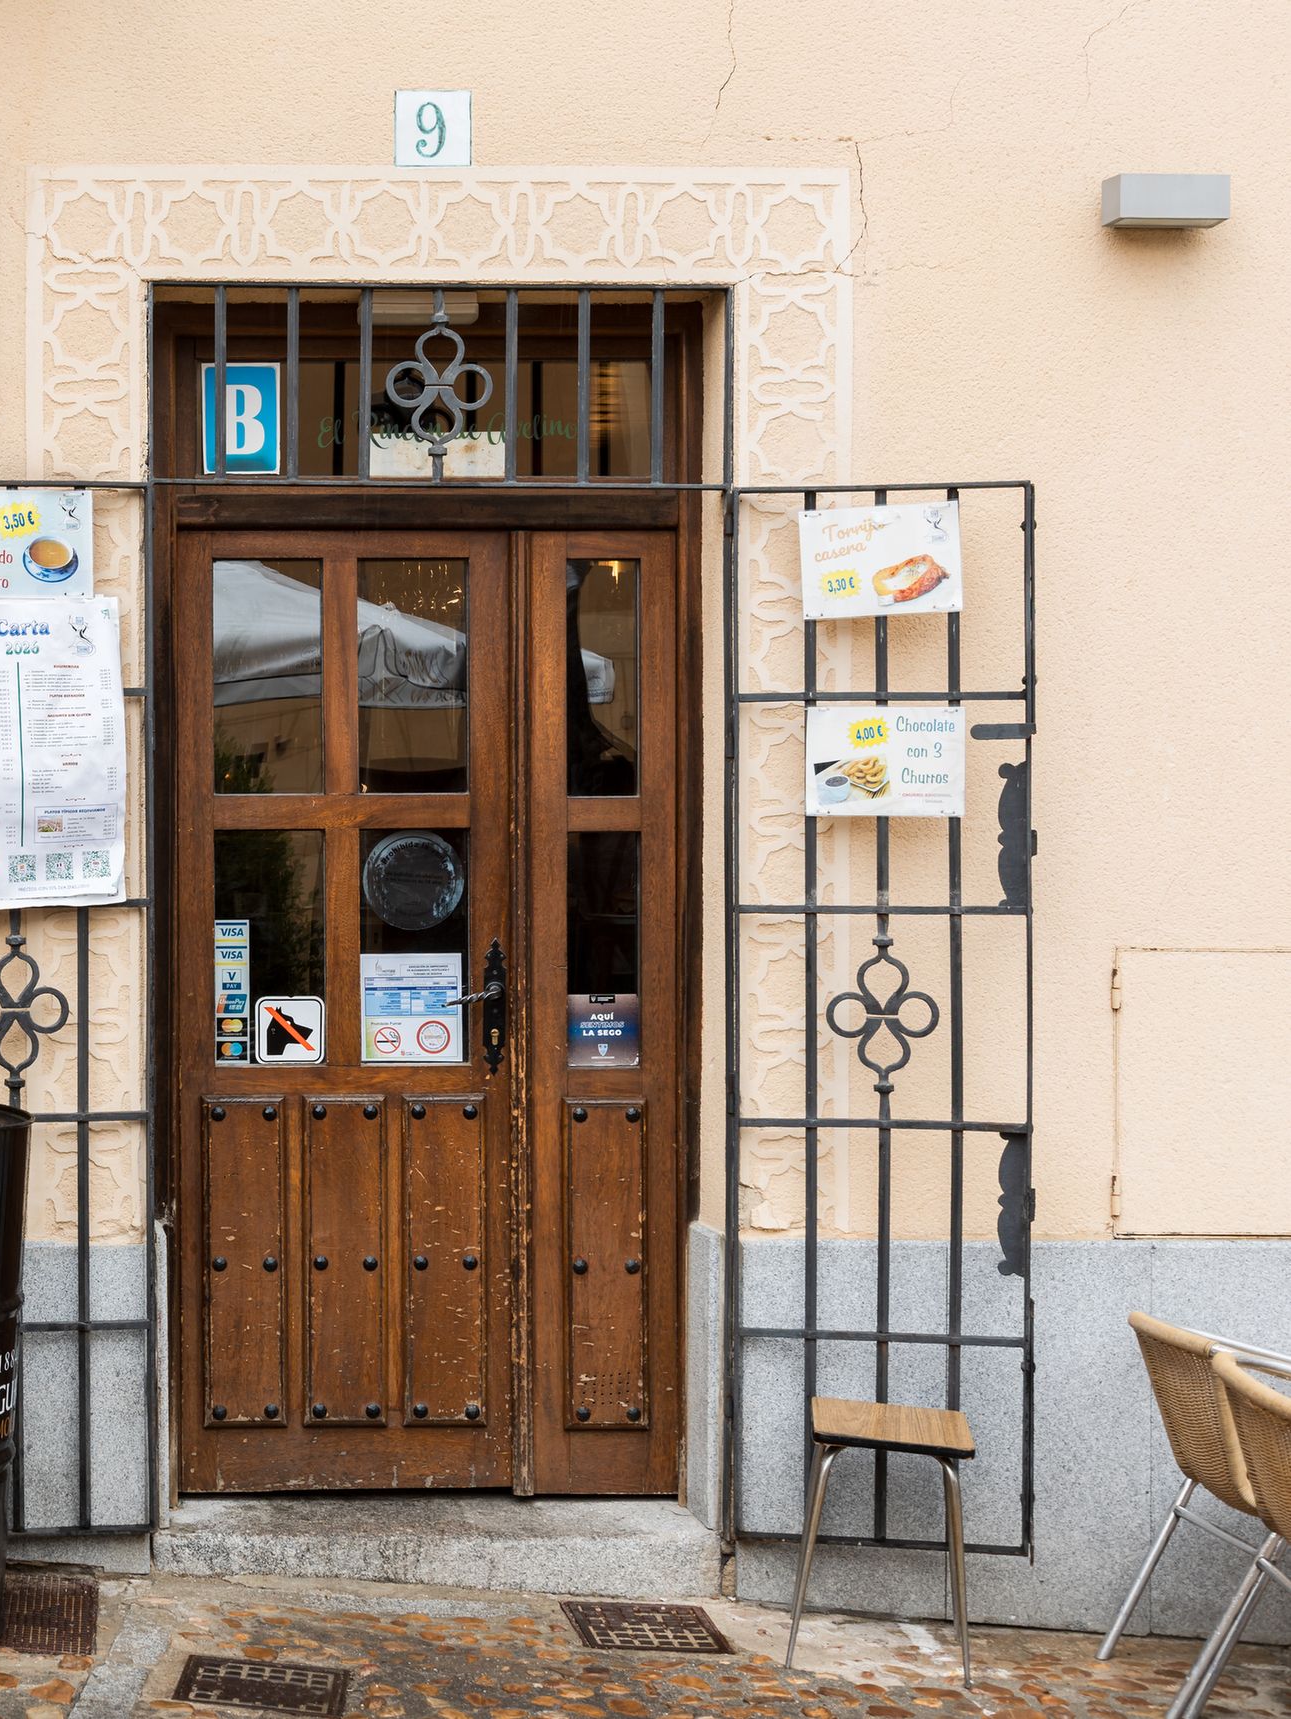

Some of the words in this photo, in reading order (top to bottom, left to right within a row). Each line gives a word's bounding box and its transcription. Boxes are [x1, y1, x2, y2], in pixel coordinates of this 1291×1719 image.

[415, 101, 446, 158] 9
[219, 383, 266, 455] B
[317, 415, 345, 449] El
[3, 512, 25, 533] 3,50
[27, 511, 35, 525] €
[814, 541, 867, 563] casera
[827, 578, 847, 594] 3,30
[848, 576, 855, 589] €
[5, 640, 40, 655] 2026
[896, 715, 956, 732] Chocolate
[856, 726, 875, 742] 4,00
[877, 725, 884, 737] €
[906, 746, 928, 759] con
[933, 741, 942, 759] 3
[901, 767, 949, 784] Churros
[220, 928, 244, 937] VISA
[220, 950, 243, 959] VISA
[227, 971, 237, 981] V
[590, 1012, 615, 1021] AQUÍ
[597, 1029, 622, 1037] SEGO
